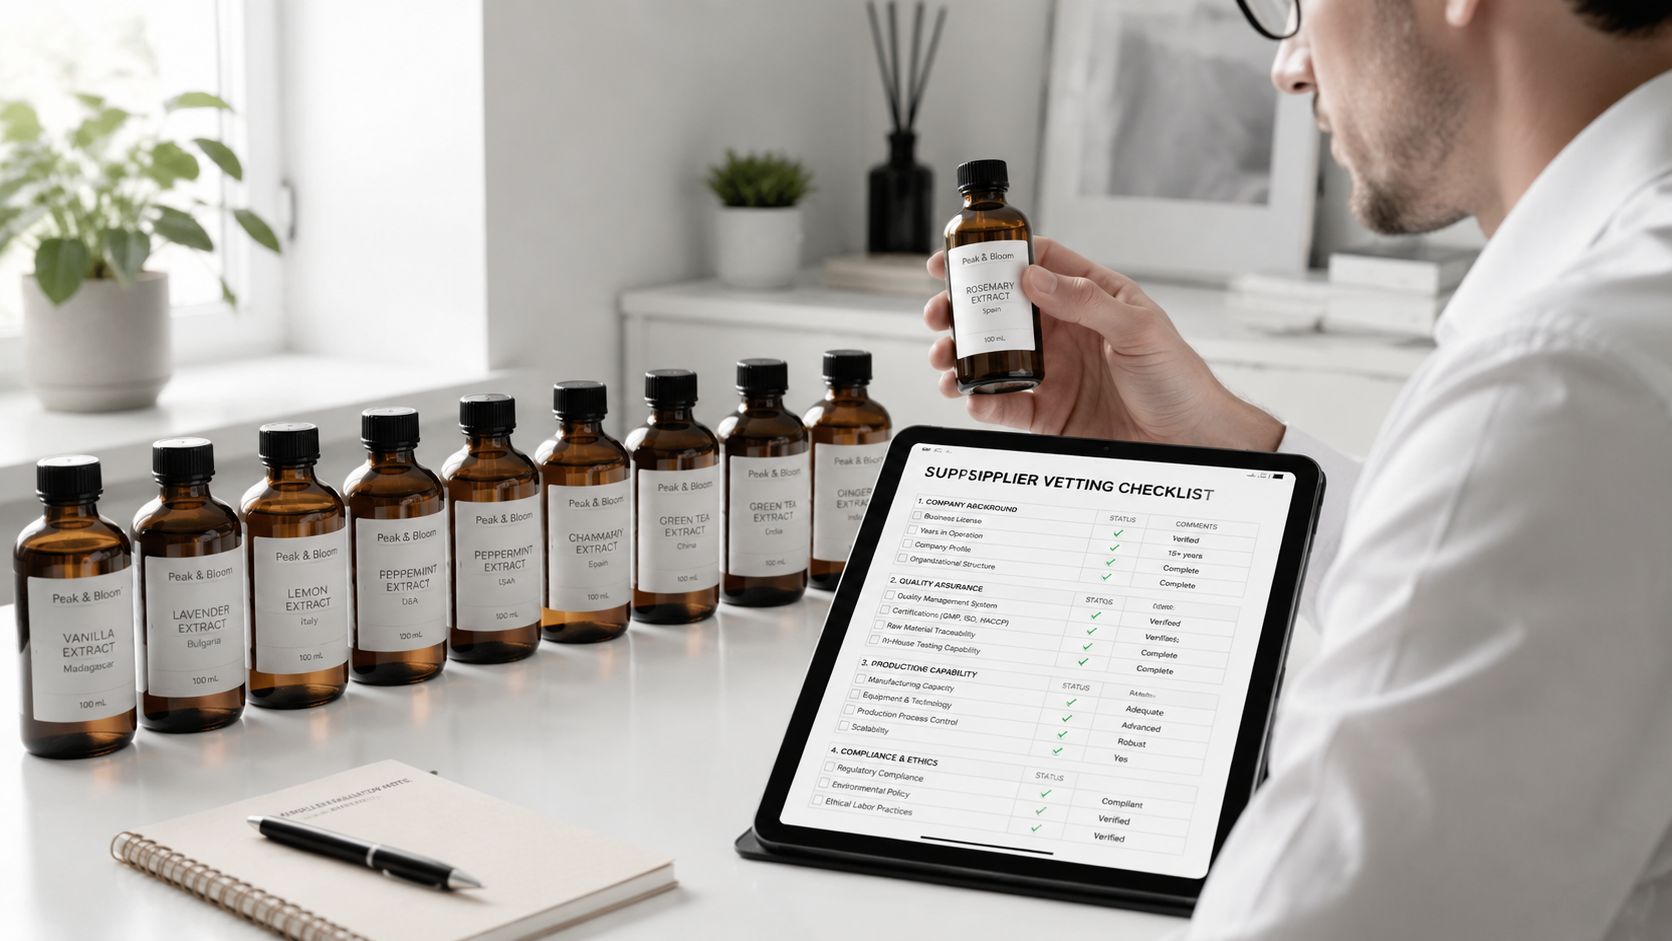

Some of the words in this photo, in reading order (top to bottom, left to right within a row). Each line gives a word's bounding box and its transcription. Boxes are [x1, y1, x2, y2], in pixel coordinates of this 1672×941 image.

[962, 256, 980, 265] Peak
[966, 282, 1015, 294] ROSEMARY
[972, 292, 1010, 304] EXTRACT
[983, 307, 1001, 315] Spain
[658, 483, 678, 492] Peak
[1044, 475, 1114, 492] VETTING
[1118, 482, 1214, 501] CHECKLIST
[569, 500, 590, 508] Peak
[750, 502, 782, 511] GREEN
[784, 500, 797, 509] TEA
[476, 515, 498, 525] Peak
[511, 512, 533, 522] Bloom
[659, 516, 693, 526] GREEN
[696, 514, 710, 523] TEA
[754, 512, 794, 523] EXTRACT
[1110, 515, 1136, 523] STATUS
[1176, 521, 1218, 530] COMMENTS
[377, 533, 400, 543] Peak
[403, 532, 410, 542] &
[413, 529, 437, 541] Bloom
[665, 526, 705, 537] EXTRACT
[949, 530, 983, 539] Operation
[576, 541, 618, 554] EXTRACT
[677, 542, 696, 550] China
[915, 542, 948, 552] Company
[276, 551, 300, 562] Peak
[302, 550, 311, 560] &
[313, 547, 338, 559] Bloom
[474, 545, 533, 560] PEPPERMINT
[484, 559, 526, 572] EXTRACT
[963, 561, 996, 570] Structure
[1163, 565, 1200, 575] Complete
[168, 572, 193, 582] Peak
[196, 571, 204, 580] &
[206, 566, 233, 580] Bloom
[386, 579, 430, 592] EXTRACT
[900, 578, 934, 588] QUALITY
[1159, 580, 1196, 590] Complete
[53, 594, 79, 604] Peak
[82, 592, 90, 602] &
[94, 589, 121, 601] Bloom
[287, 586, 328, 599] LEMON
[285, 598, 332, 612] EXTRACT
[173, 605, 230, 621] LAVENDER
[178, 619, 227, 633] EXTRACT
[887, 622, 902, 630] Raw
[904, 624, 934, 633] Material
[935, 628, 976, 639] Traceability
[63, 629, 115, 643] VANILLA
[187, 637, 221, 649] Bulgaria
[63, 642, 116, 658] EXTRACT
[1141, 649, 1178, 659] Complete
[300, 654, 312, 662] 100
[313, 653, 324, 661] mL
[930, 667, 978, 678] CAPABILITY
[1137, 665, 1174, 675] Complete
[193, 677, 206, 685] 100
[208, 675, 219, 684] mL
[1062, 682, 1090, 691] STATUS
[79, 700, 94, 709] 100
[95, 699, 106, 707] mL
[857, 707, 897, 719] Production
[930, 716, 959, 726] Control
[1126, 705, 1164, 717] Adequate
[1121, 722, 1162, 733] Advanced
[1118, 738, 1146, 748] Robust
[841, 748, 898, 762] COMPLIANCE
[907, 756, 939, 767] ETHICS
[1114, 755, 1128, 763] Yes
[878, 770, 924, 783] Compliance
[1035, 772, 1064, 781] STATUS
[887, 788, 911, 799] Policy
[826, 798, 852, 807] Ethical
[853, 801, 875, 810] Labor
[877, 805, 913, 816] Practices
[1099, 815, 1131, 825] Verified
[1094, 832, 1126, 843] Verified
